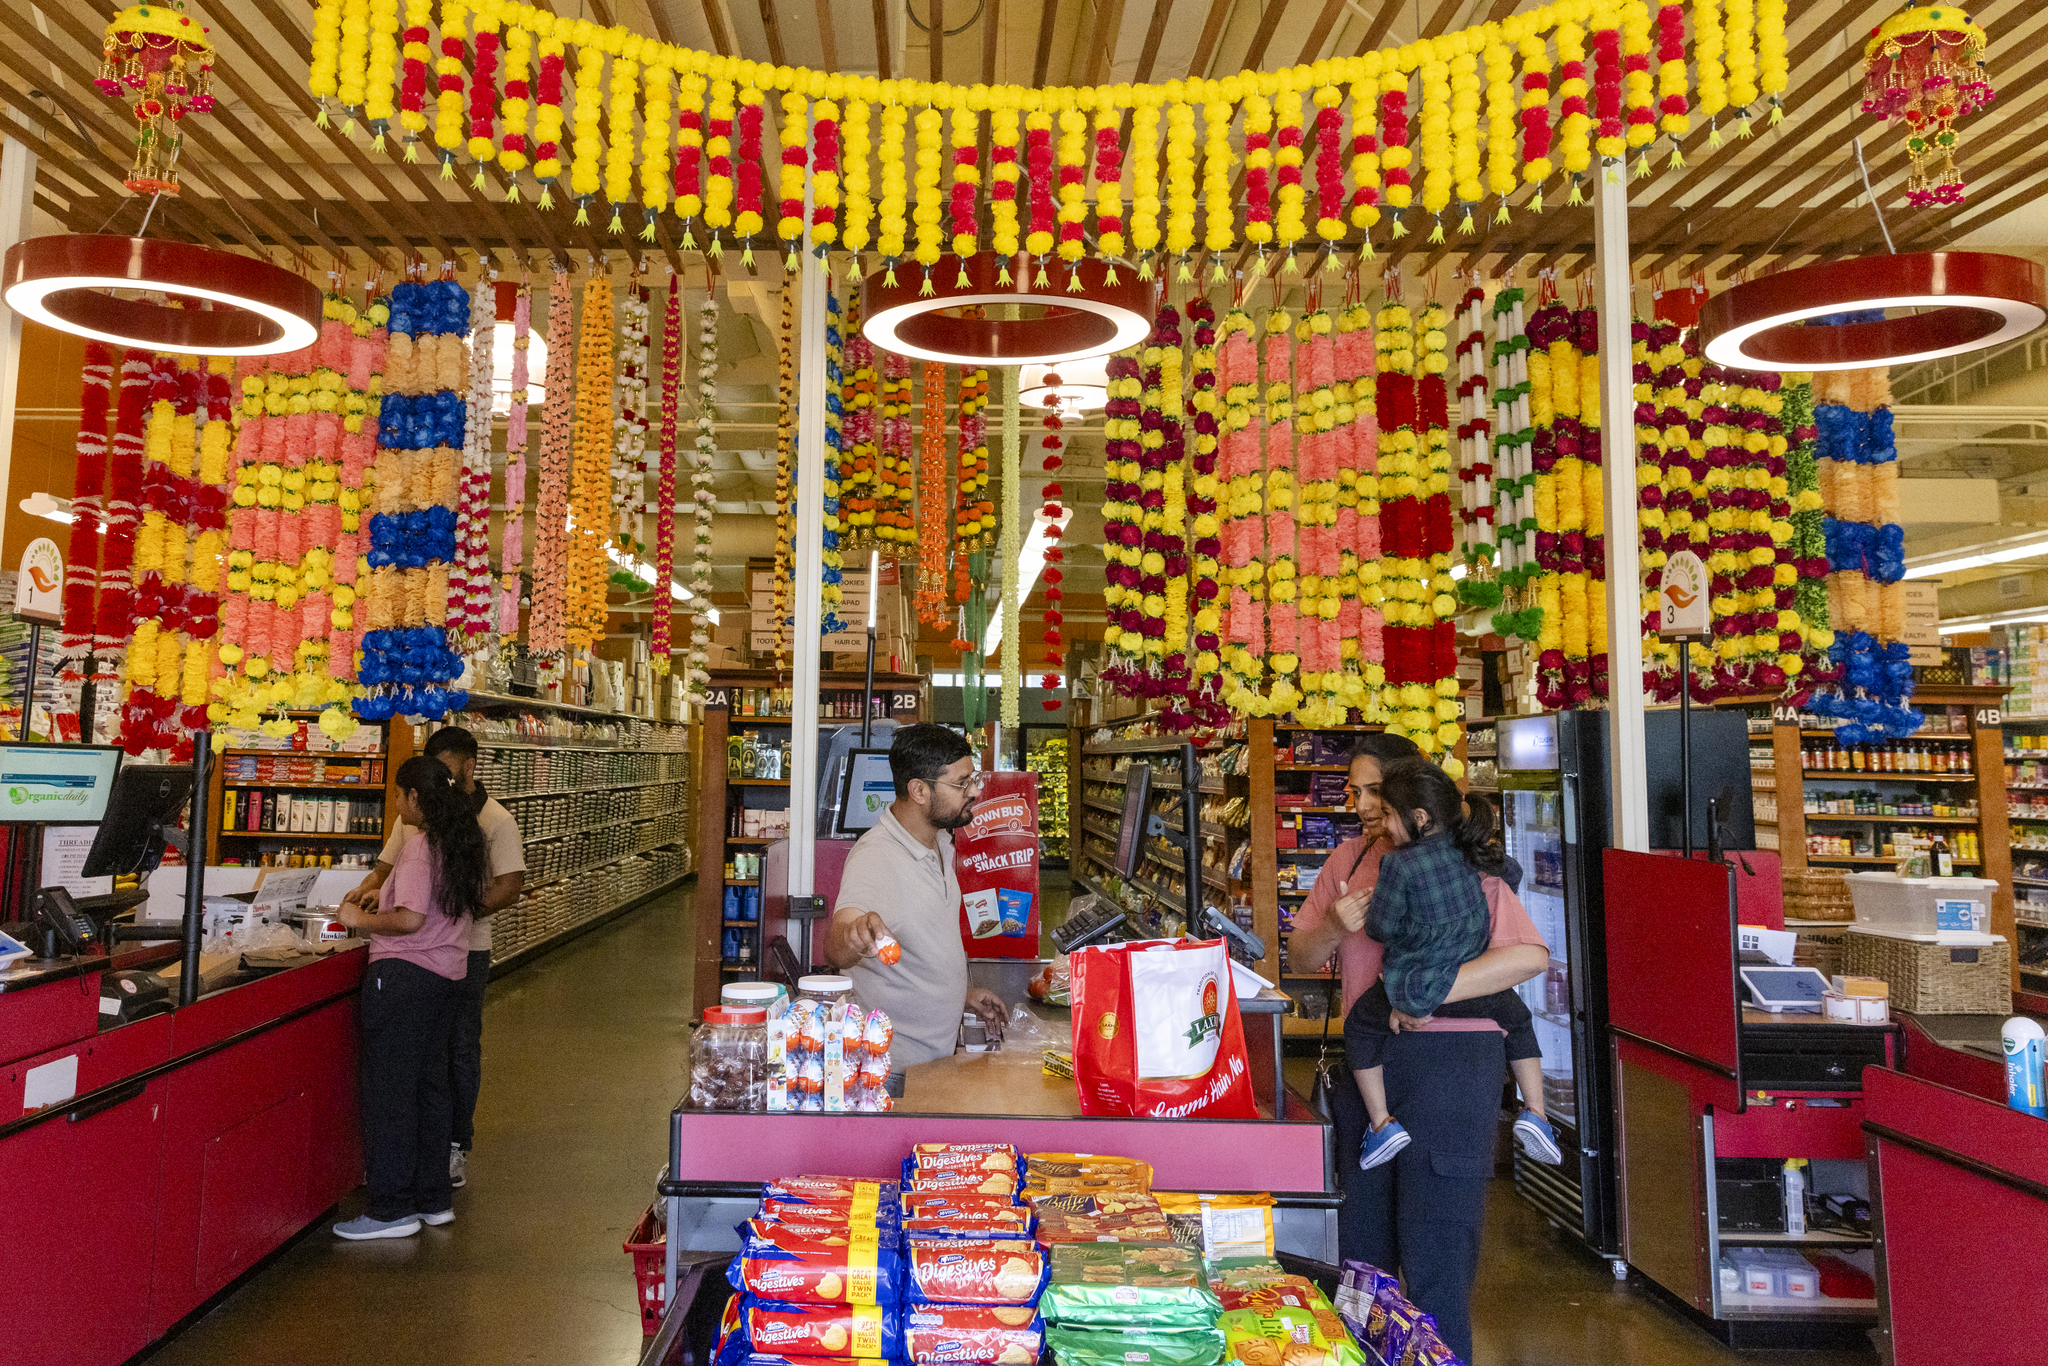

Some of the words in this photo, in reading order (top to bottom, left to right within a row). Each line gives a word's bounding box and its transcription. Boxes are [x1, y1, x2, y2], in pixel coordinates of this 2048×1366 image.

[28, 586, 33, 604] 1
[1667, 605, 1675, 624] 3
[834, 638, 851, 646] HAIR
[706, 690, 728, 706] 2A
[893, 694, 916, 709] 2B
[1457, 702, 1466, 716] B
[1773, 707, 1799, 721] 4A
[1976, 709, 2001, 724] 4B
[1001, 805, 1024, 818] BUS
[963, 858, 973, 867] GO
[972, 854, 982, 863] ON
[982, 852, 988, 860] A
[975, 854, 1009, 873] SNACK
[1009, 847, 1035, 865] TRIP
[252, 903, 272, 912] Hawkins
[321, 932, 347, 940] Hawkins
[2008, 1062, 2019, 1097] Inhaler
[1150, 1089, 1209, 1118] Laxmi
[1210, 1071, 1232, 1103] Hain
[921, 1153, 983, 1169] Digestives
[916, 1174, 984, 1191] Digestives
[852, 1269, 872, 1280] GREAT
[919, 1257, 997, 1283] Digestives
[749, 1275, 805, 1292] Digestives
[857, 1320, 877, 1332] GREAT
[755, 1327, 810, 1344] Digestives
[915, 1347, 995, 1364] Digestives
